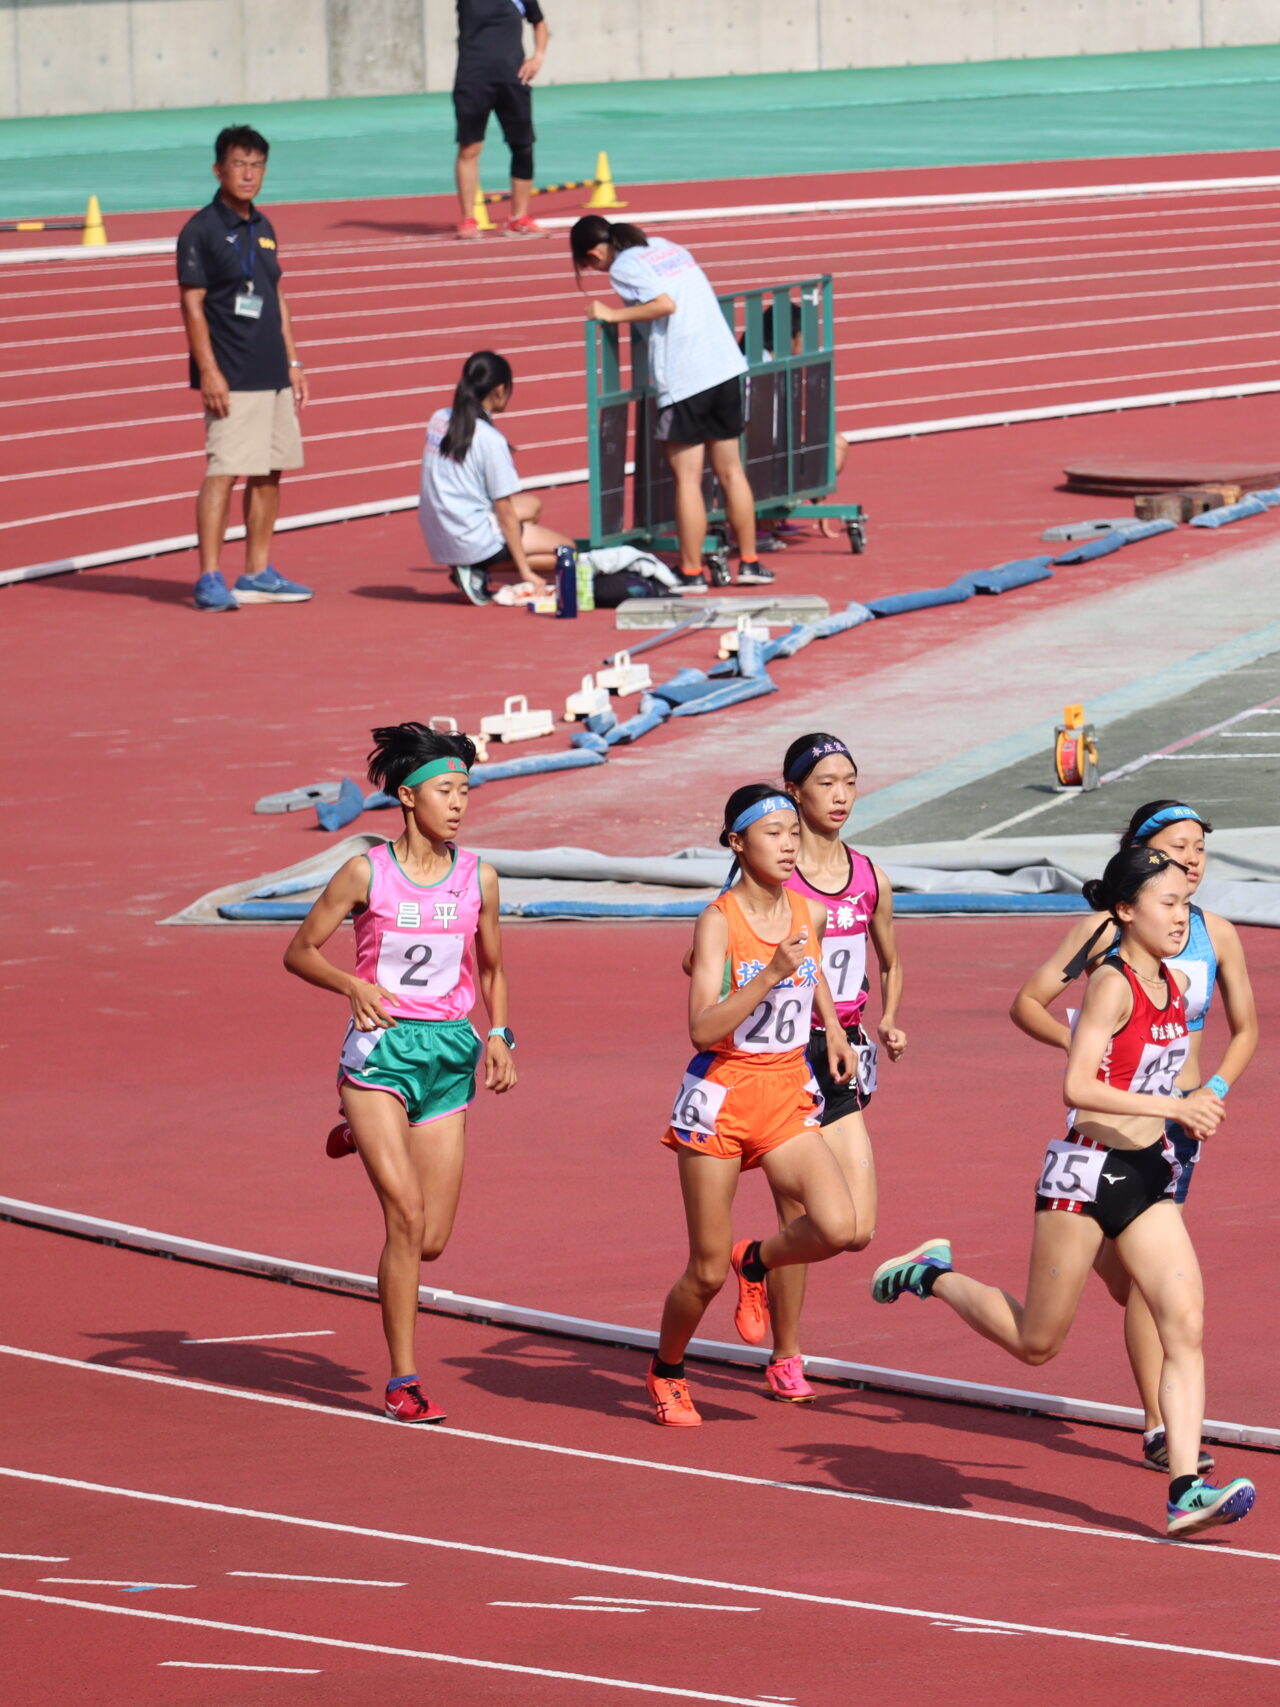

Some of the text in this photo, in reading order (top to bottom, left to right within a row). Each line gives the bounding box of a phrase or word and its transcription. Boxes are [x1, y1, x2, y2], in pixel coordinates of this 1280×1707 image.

[396, 902, 458, 929] 昌平
[400, 944, 433, 987] 2
[829, 949, 850, 995] 9
[745, 1000, 801, 1044] 26
[1136, 1049, 1186, 1096] 25
[1041, 1149, 1090, 1193] 25
